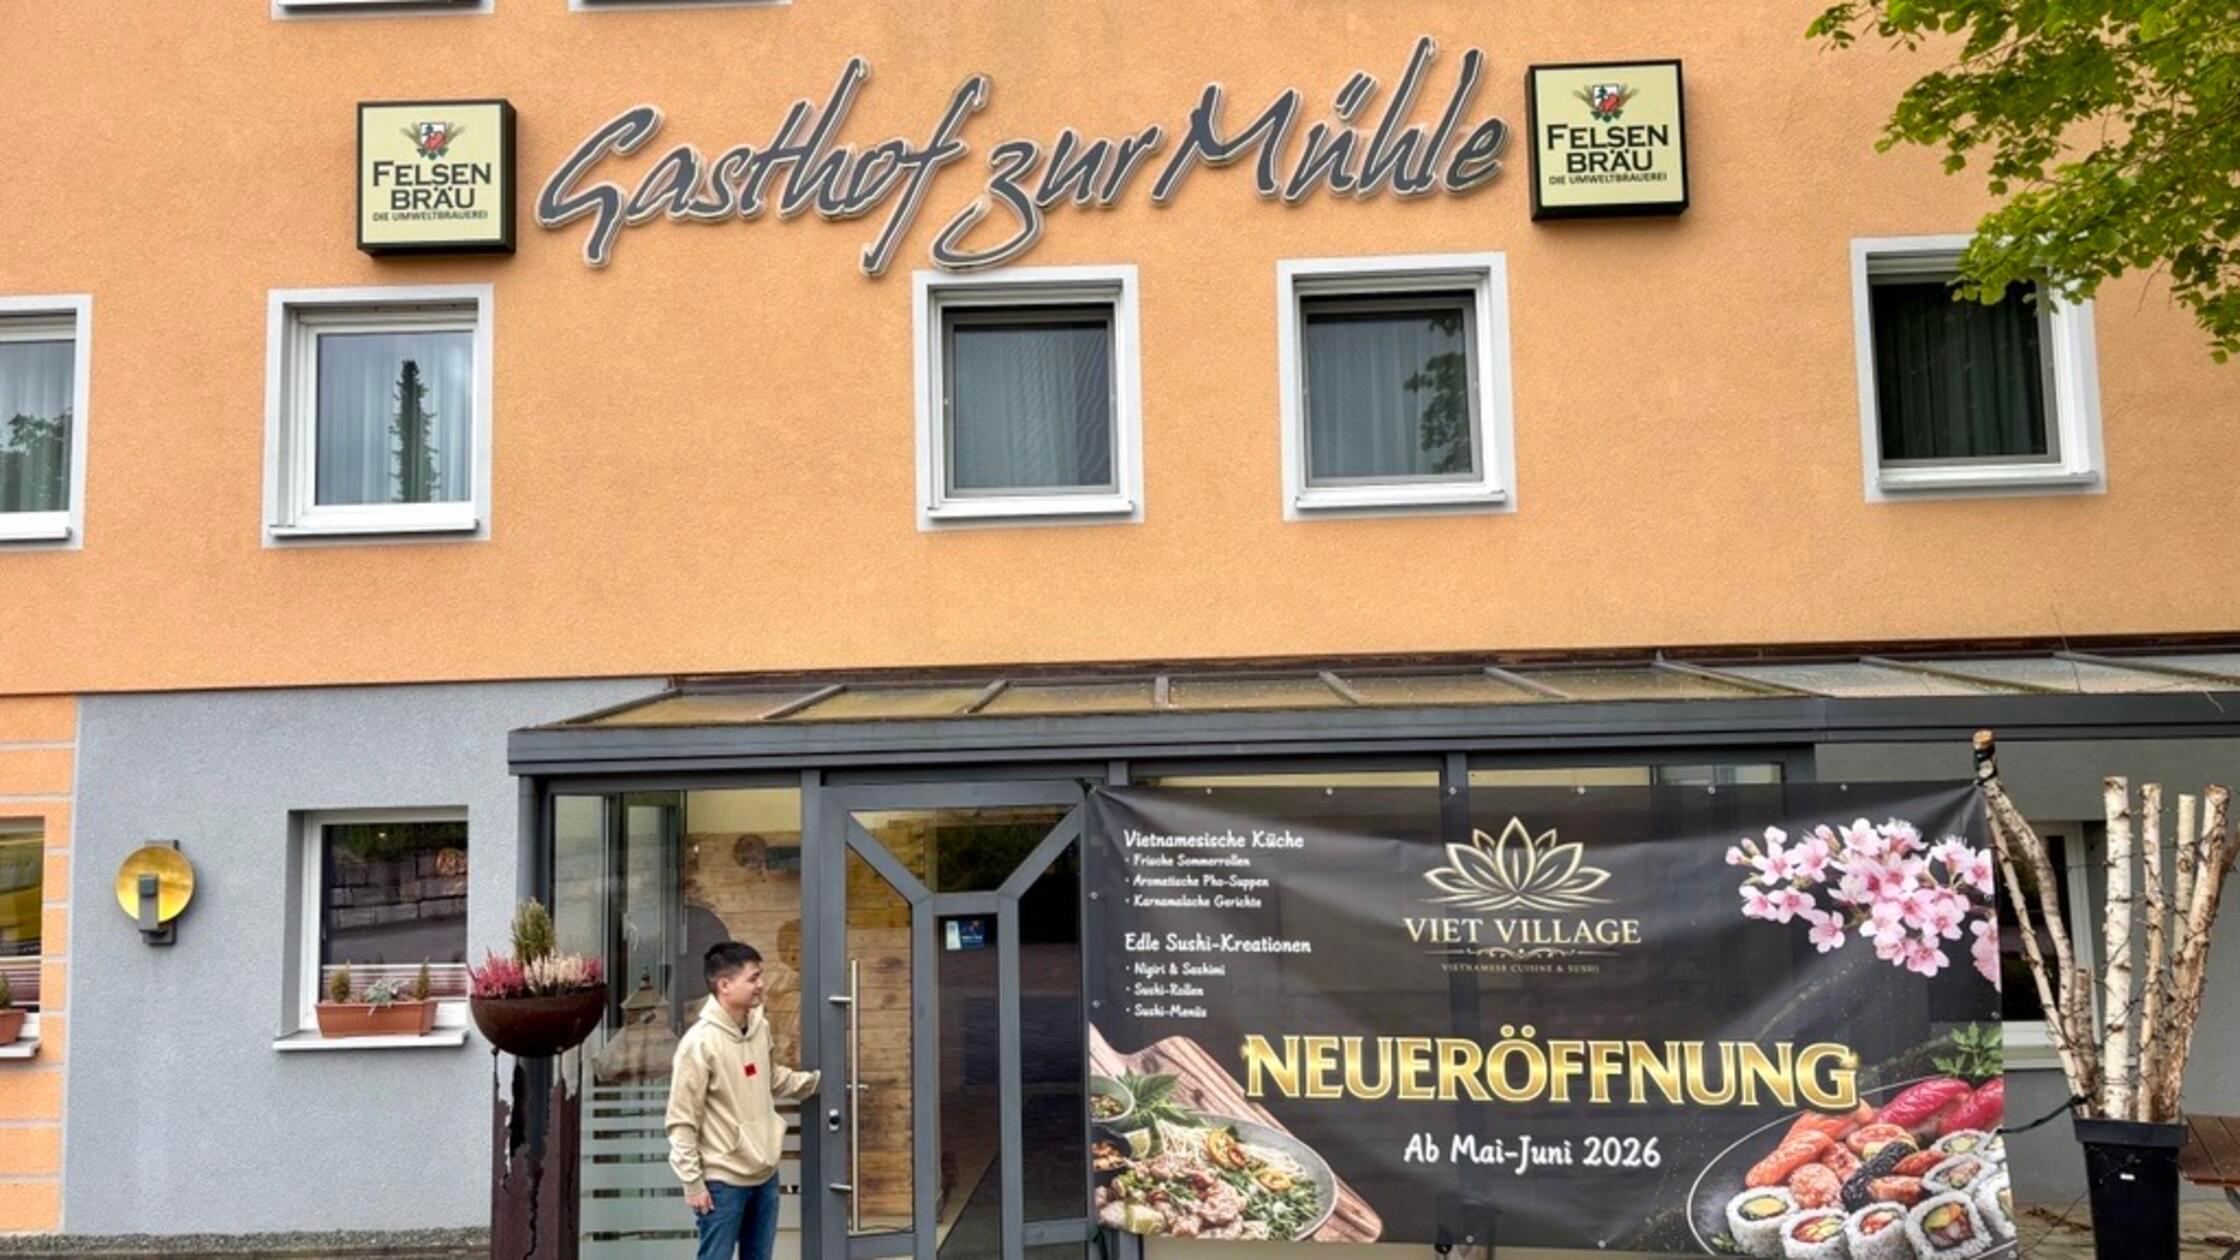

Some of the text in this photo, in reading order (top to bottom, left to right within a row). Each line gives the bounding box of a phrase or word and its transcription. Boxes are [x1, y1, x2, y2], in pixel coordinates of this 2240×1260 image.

[1547, 124, 1668, 150] FELSEN
[535, 35, 1508, 277] Gasthof zur Mühle
[1567, 148, 1653, 173] BRÄU
[373, 161, 491, 186] FELSEN
[1549, 175, 1566, 185] DIE
[391, 187, 475, 210] BRÄU
[372, 212, 390, 221] DIE
[1124, 829, 1305, 849] Vietnamesische Küche
[1133, 854, 1250, 867] Frische Sommerrollen
[1133, 874, 1270, 891] Aromatische Pho-Suppen
[1214, 894, 1262, 908] Gerichte
[1403, 918, 1641, 944] VIET VILLAGE
[1124, 932, 1312, 953] Edle Sushi-Kreationen
[1134, 962, 1166, 979] Nigiri
[1169, 962, 1179, 975] &
[1441, 963, 1600, 973] VIETNAMESE CUISINE & SUSHI
[1134, 982, 1204, 997] Sushi-Rollen
[1134, 1003, 1208, 1018] Sushi-Menüs
[1242, 1024, 1859, 1109] NEUERÖFFNUNG
[1403, 1133, 1662, 1176] Ab Mai-Juni 2026
